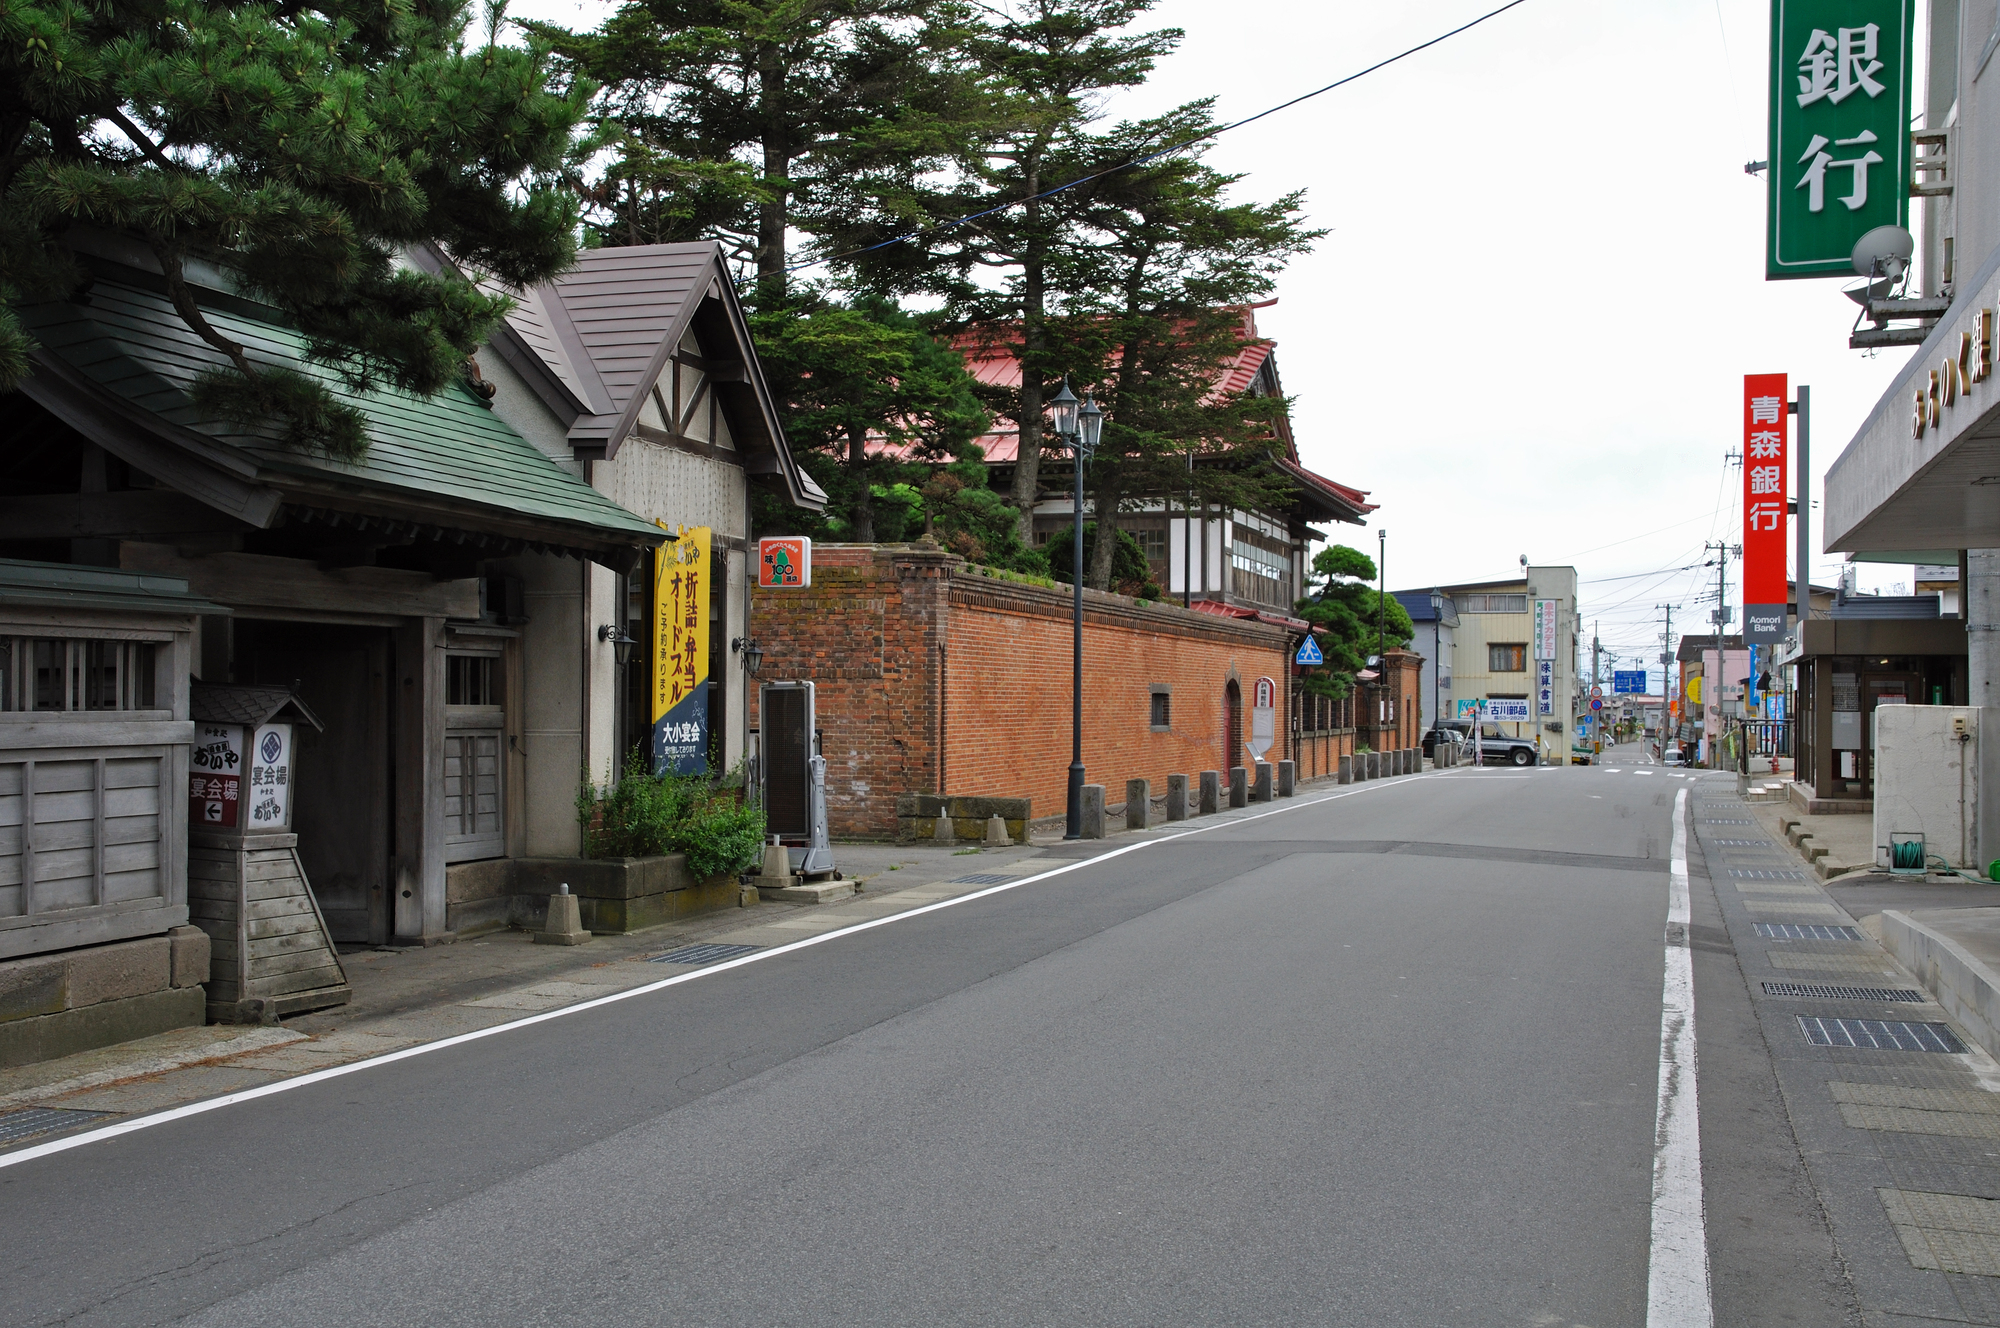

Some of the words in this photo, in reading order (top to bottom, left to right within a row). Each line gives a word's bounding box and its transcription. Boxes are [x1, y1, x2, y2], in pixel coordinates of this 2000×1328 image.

[1794, 22, 1887, 214] 銀行
[1750, 396, 1781, 531] 青森銀行
[772, 564, 793, 576] 100
[684, 571, 698, 690] 折詰・弁当
[1544, 601, 1554, 658] 金木アカデミー
[1750, 615, 1781, 624] Aomori
[1754, 624, 1777, 632] Bank
[669, 571, 682, 704] オードブル
[1491, 705, 1527, 715] 古川部品
[1540, 689, 1551, 713] 書道
[663, 721, 700, 744] 大小宴会
[194, 746, 239, 769] あいや
[252, 766, 287, 786] 宴会場
[191, 777, 238, 800] 宴会場
[254, 804, 281, 821] あいや
